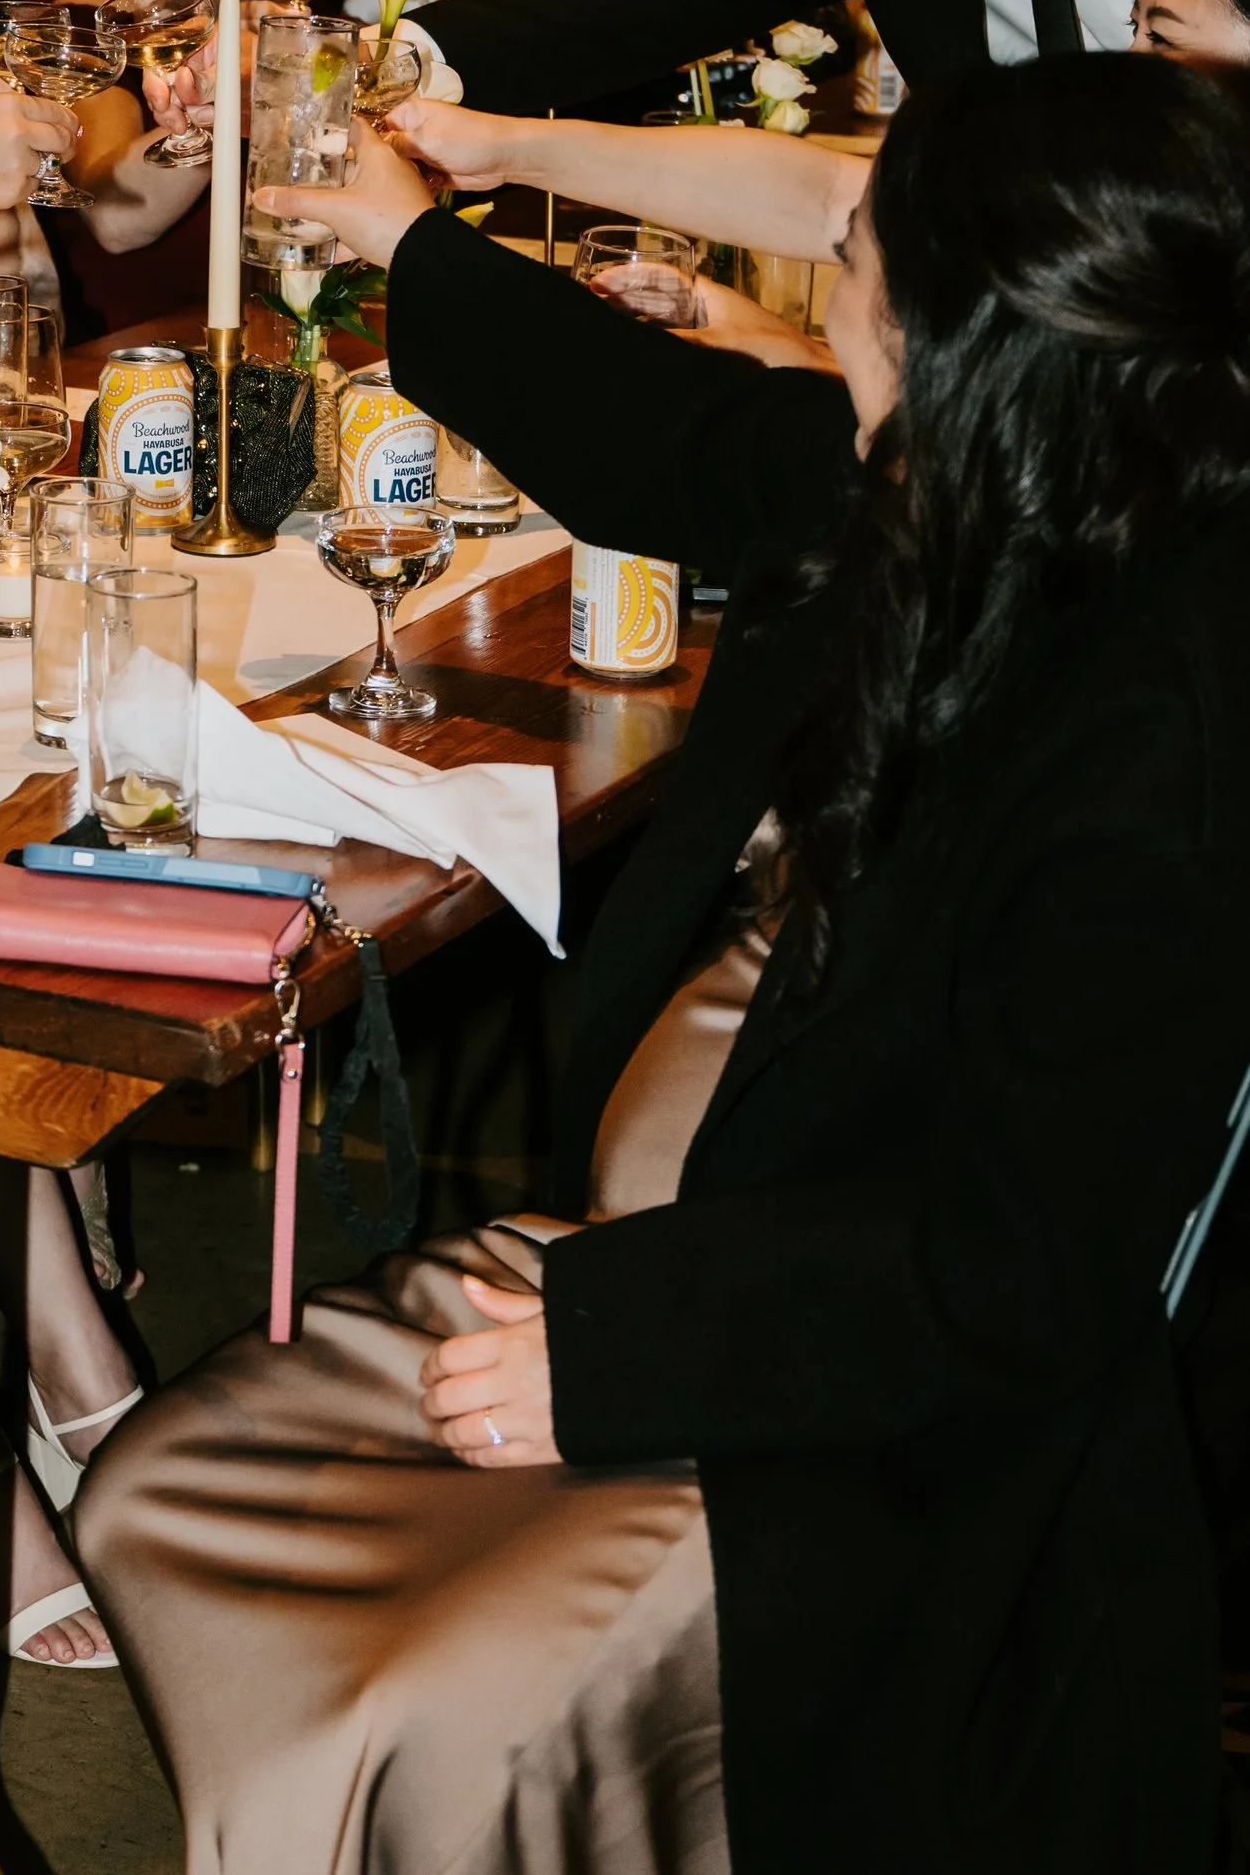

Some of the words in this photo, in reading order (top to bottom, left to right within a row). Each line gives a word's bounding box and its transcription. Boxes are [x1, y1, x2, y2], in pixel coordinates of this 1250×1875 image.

[132, 420, 190, 438] Beachwood
[143, 438, 184, 449] HAYABUSA
[124, 446, 193, 475] LAGER
[394, 464, 432, 477] HAYABUSA
